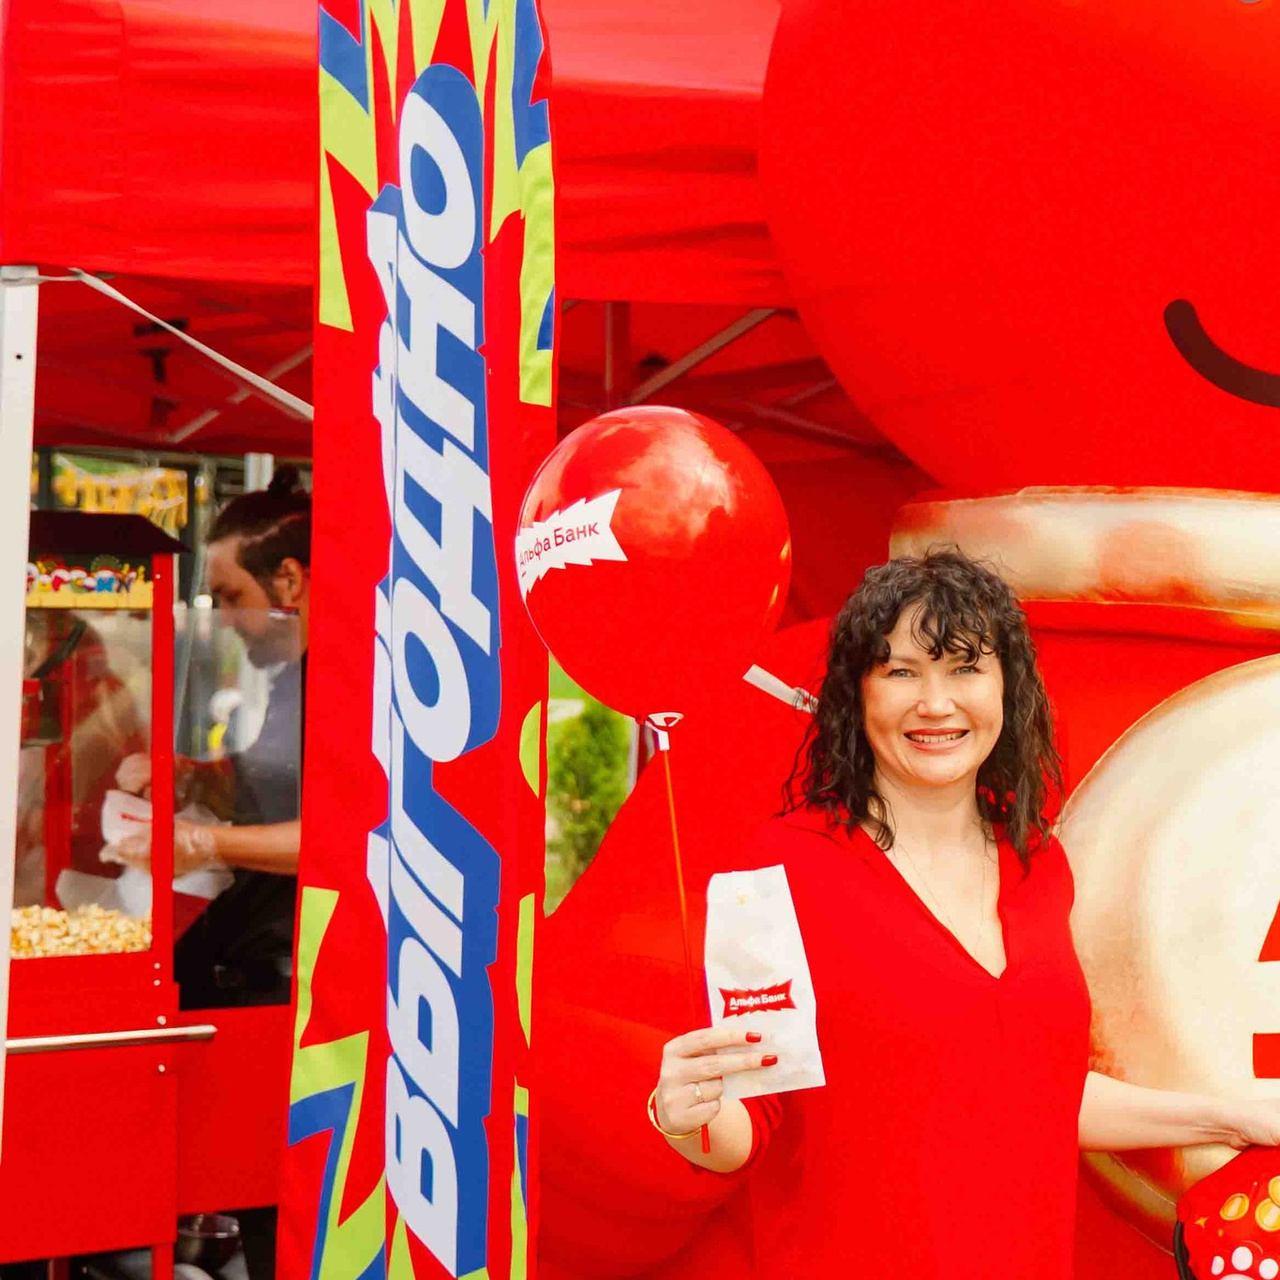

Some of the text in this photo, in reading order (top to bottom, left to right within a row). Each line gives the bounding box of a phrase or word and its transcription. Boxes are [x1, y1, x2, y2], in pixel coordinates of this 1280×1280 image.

[553, 522, 600, 547] Банк
[385, 91, 492, 1278] ВЫГОДНО
[761, 992, 787, 1004] Банк
